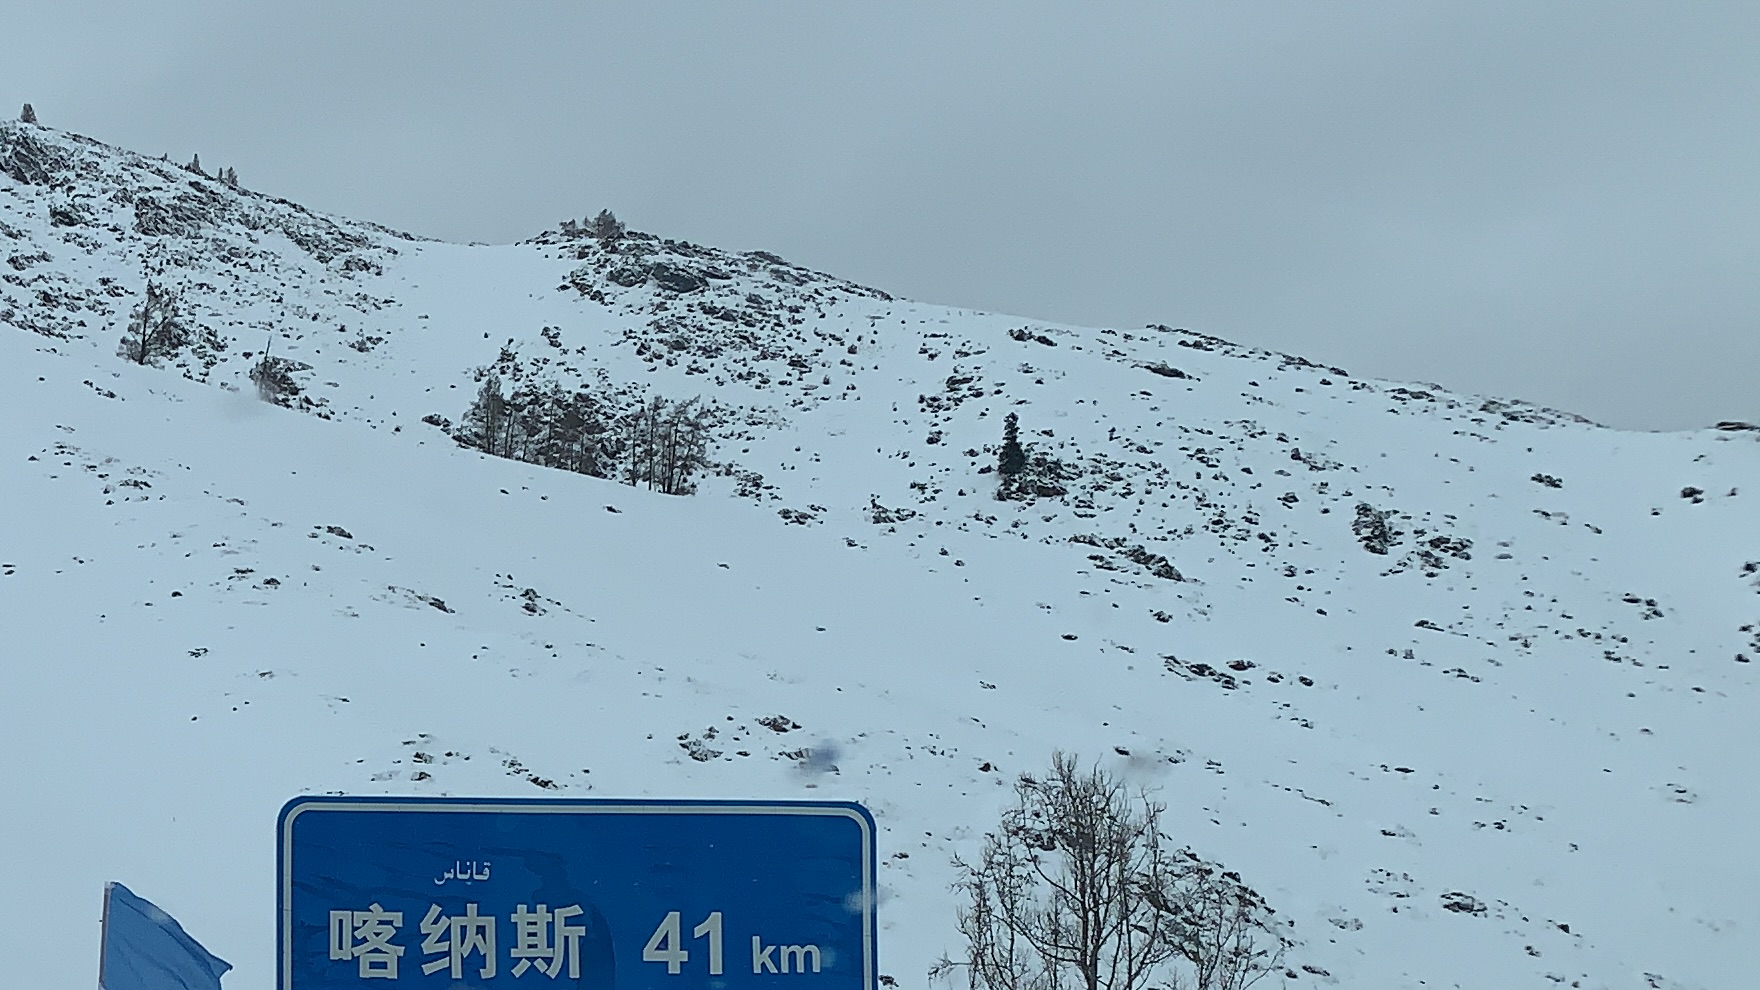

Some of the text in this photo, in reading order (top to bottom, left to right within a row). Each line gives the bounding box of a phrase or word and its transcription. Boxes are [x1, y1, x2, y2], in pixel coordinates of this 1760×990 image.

[329, 902, 821, 980] 喀纳斯 41 km
